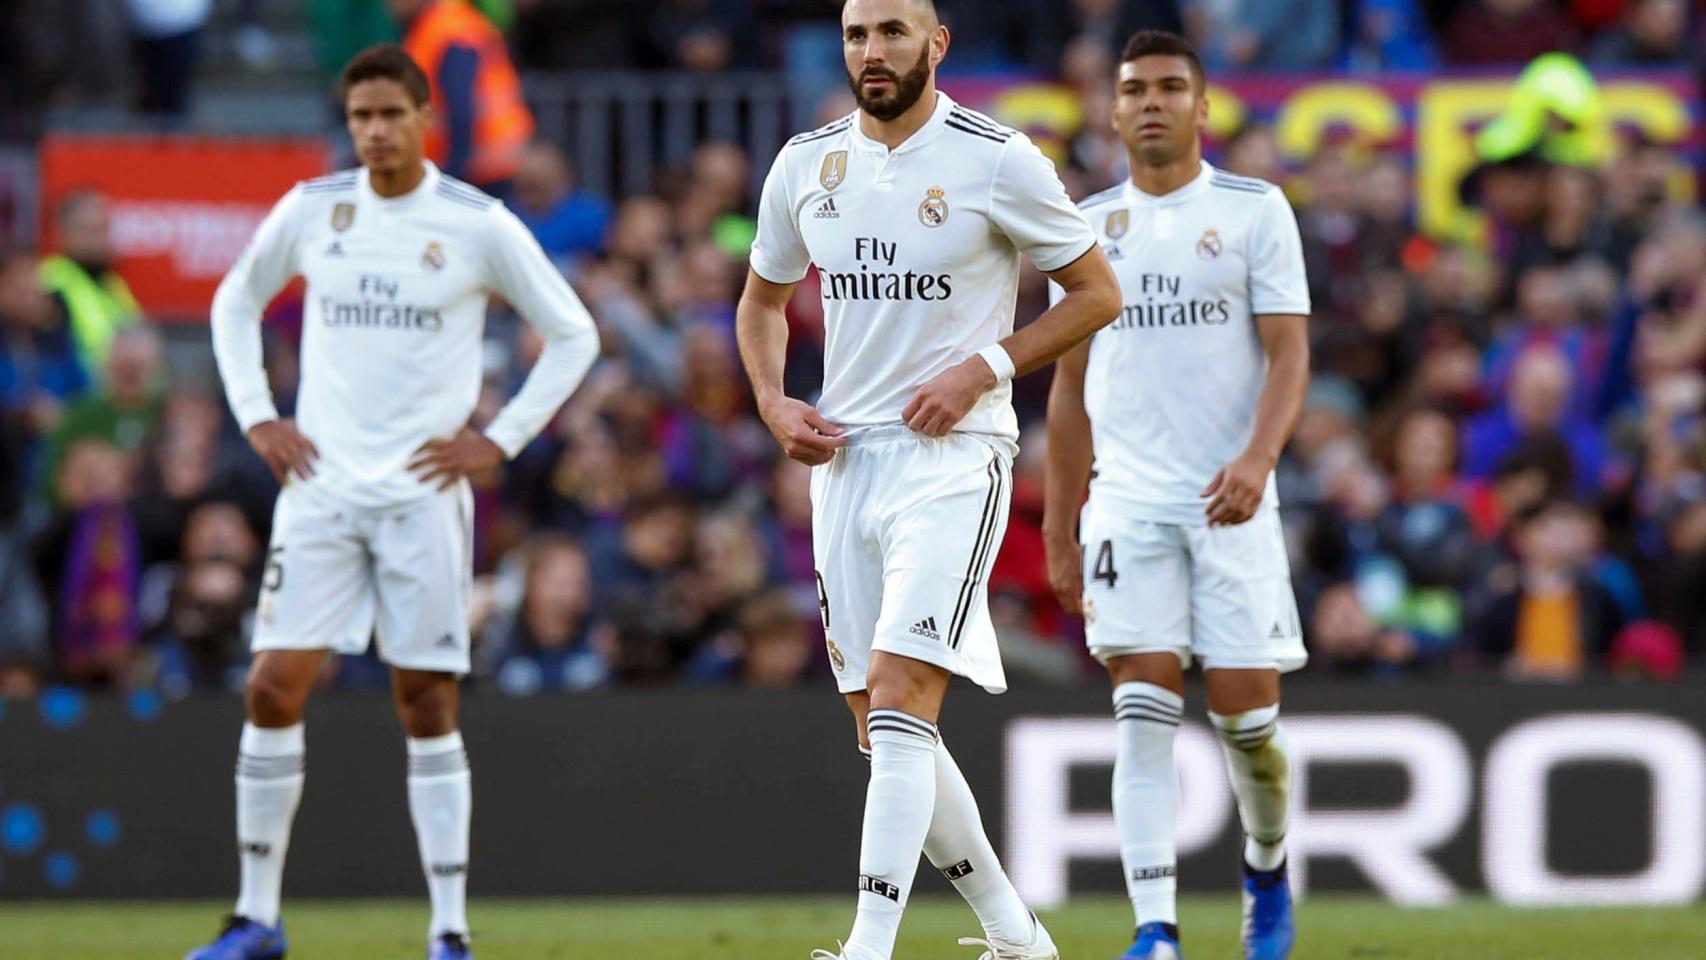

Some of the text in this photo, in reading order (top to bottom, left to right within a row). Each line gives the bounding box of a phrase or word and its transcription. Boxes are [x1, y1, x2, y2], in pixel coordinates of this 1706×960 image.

[813, 211, 841, 219] adidas
[855, 237, 897, 266] Fly
[358, 277, 399, 299] Fly
[1141, 274, 1180, 297] Fly
[1111, 297, 1229, 330] mirates
[909, 626, 940, 641] adidas
[1006, 713, 1706, 907] PRO
